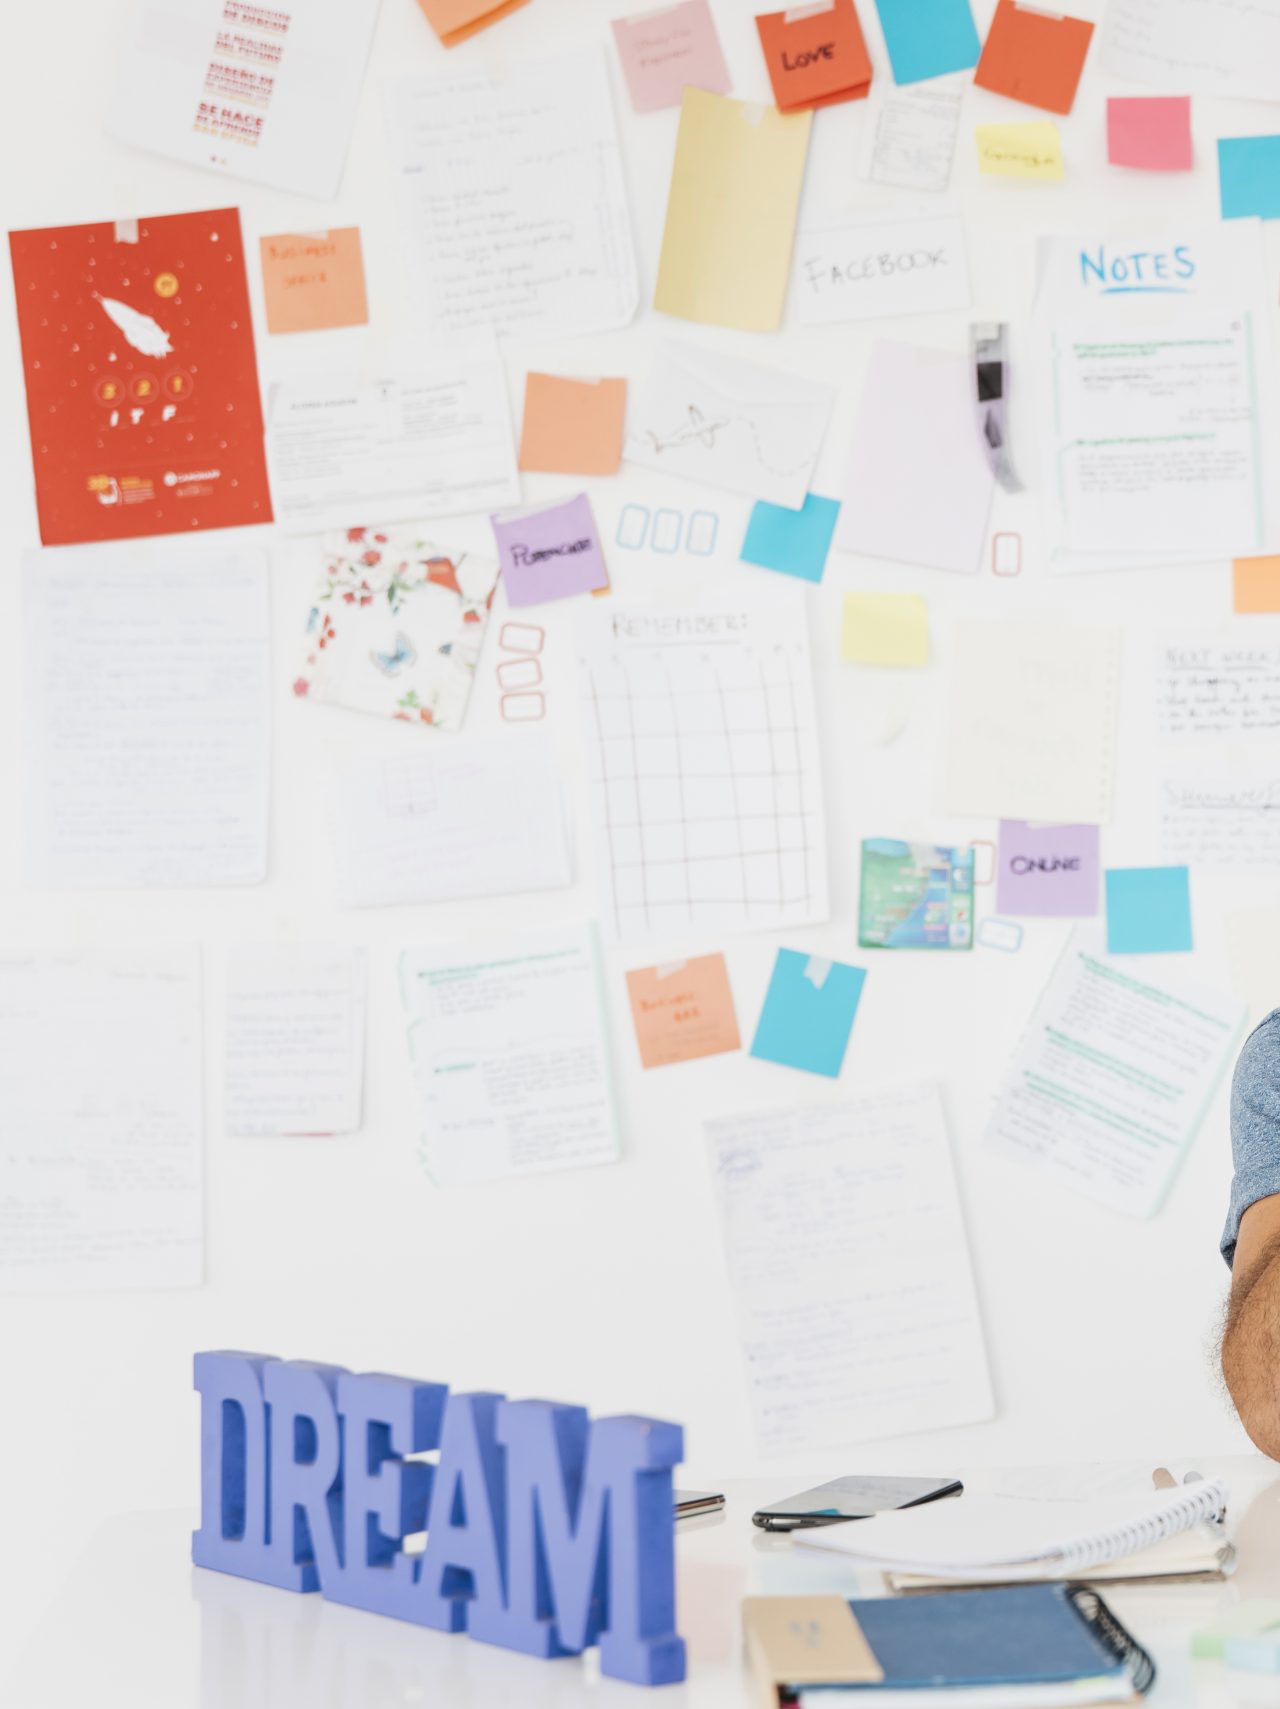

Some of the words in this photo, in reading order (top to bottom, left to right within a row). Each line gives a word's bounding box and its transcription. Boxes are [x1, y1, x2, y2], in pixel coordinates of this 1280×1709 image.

[782, 43, 836, 72] LOVE
[803, 248, 949, 293] FACEBOOK
[1080, 245, 1197, 286] NOTES
[1009, 854, 1082, 876] ONLINE
[192, 1349, 687, 1687] DREAM
